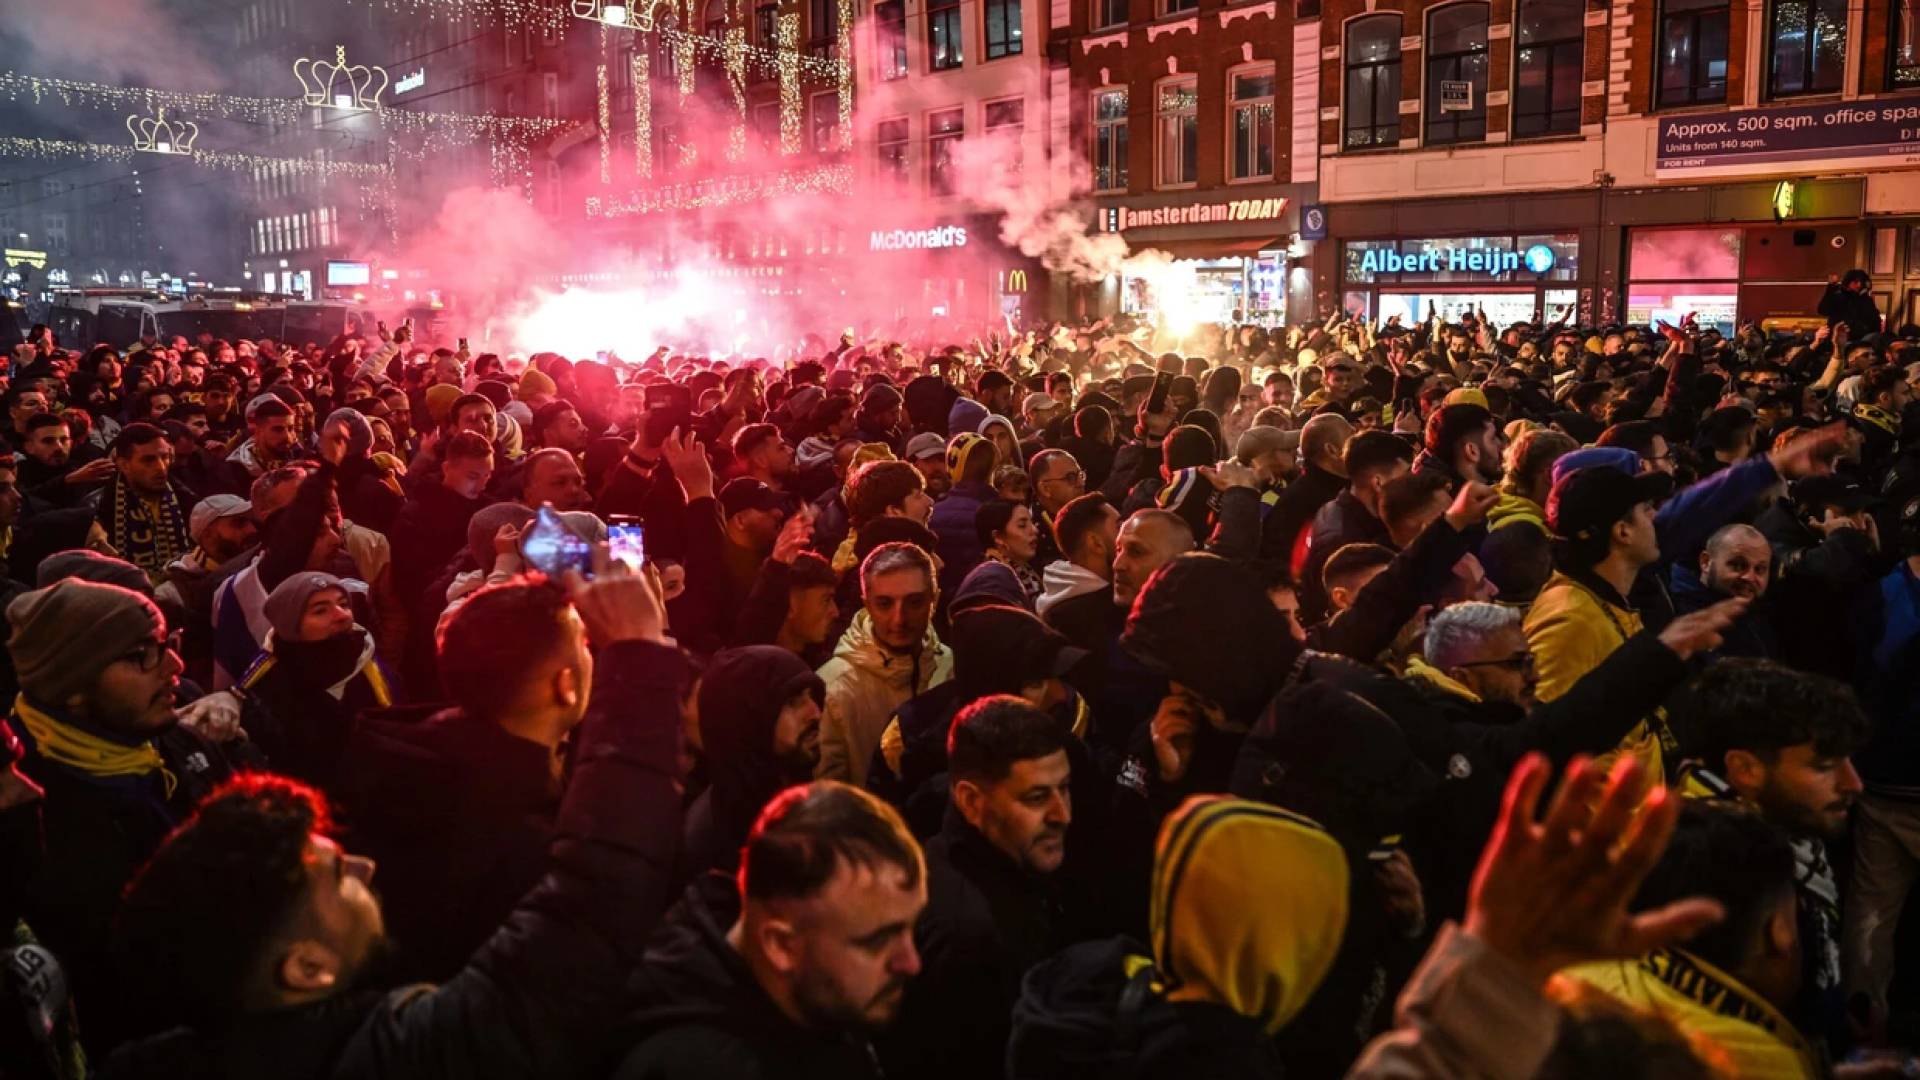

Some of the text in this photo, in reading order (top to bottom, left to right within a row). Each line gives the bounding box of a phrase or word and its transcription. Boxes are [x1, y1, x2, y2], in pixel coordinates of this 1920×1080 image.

[1665, 106, 1920, 139] Approx. 500 sqm. office spa
[1665, 142, 1692, 153] Units
[1694, 141, 1718, 151] from
[1720, 139, 1737, 149] 140
[1663, 159, 1706, 168] FOR RENT
[870, 224, 967, 250] McDonald's
[1361, 246, 1519, 276] Albert Heijn
